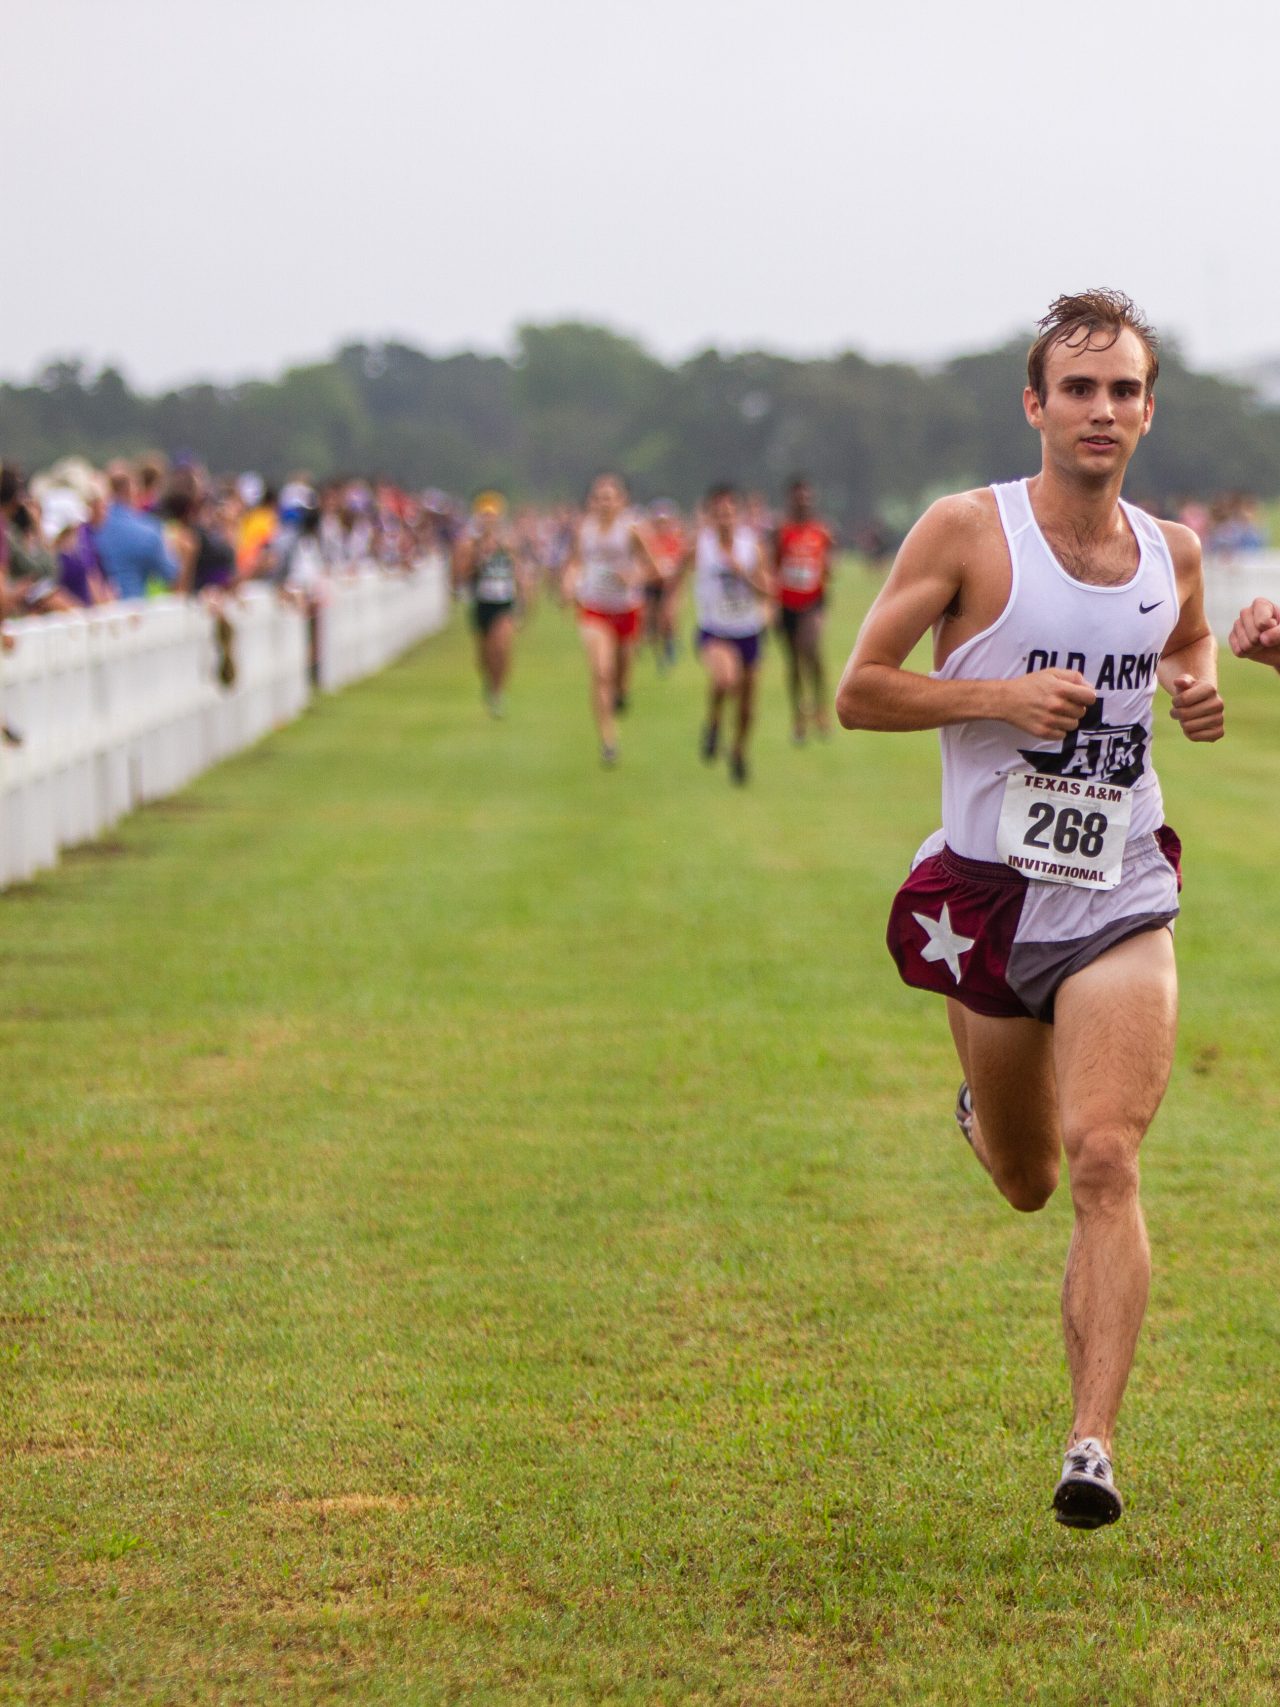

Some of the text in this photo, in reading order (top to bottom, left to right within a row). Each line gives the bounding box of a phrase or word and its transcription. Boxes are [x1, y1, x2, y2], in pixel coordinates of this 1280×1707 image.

[1023, 774, 1122, 803] TEXAS A&M
[1022, 801, 1108, 858] 268
[1008, 855, 1107, 883] INVITATIONAL
